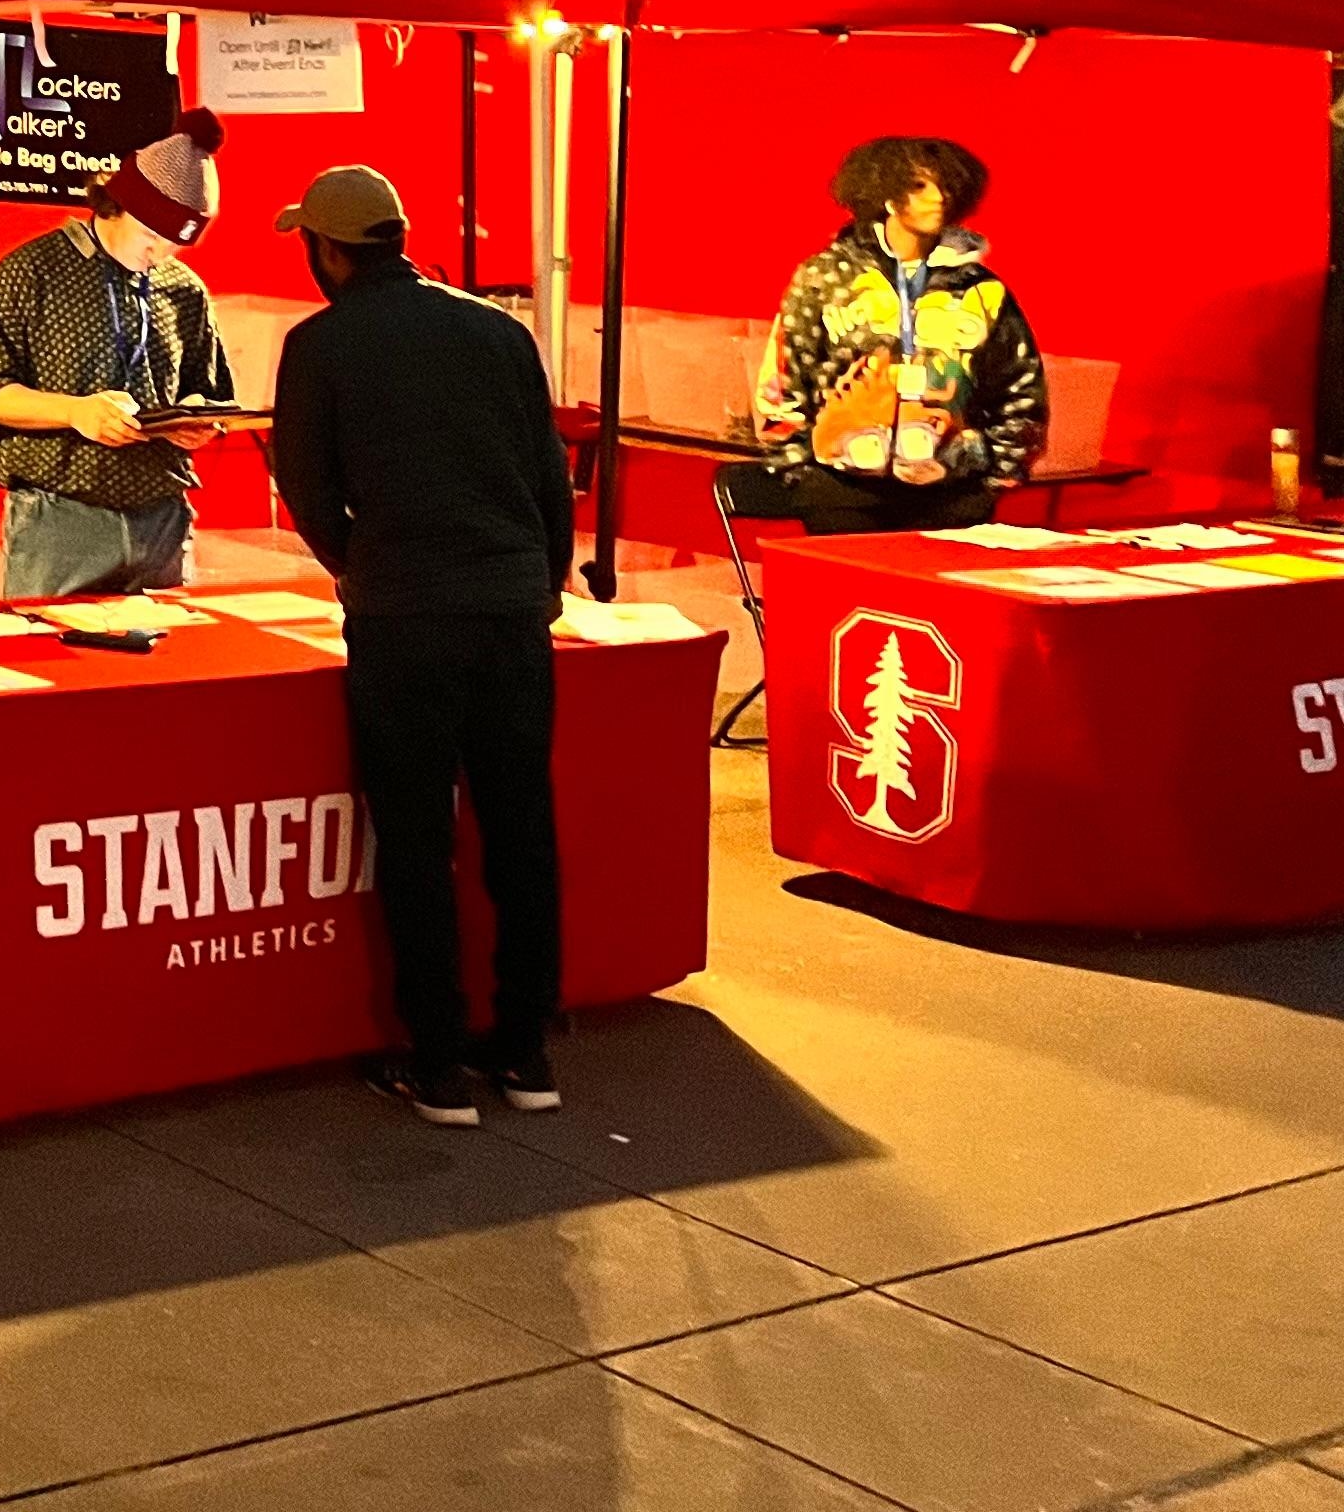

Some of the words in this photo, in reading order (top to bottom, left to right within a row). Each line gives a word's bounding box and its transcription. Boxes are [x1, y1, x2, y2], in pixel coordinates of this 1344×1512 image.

[17, 146, 56, 174] Bag
[60, 150, 121, 173] Check
[166, 918, 337, 970] ATHLETICS
